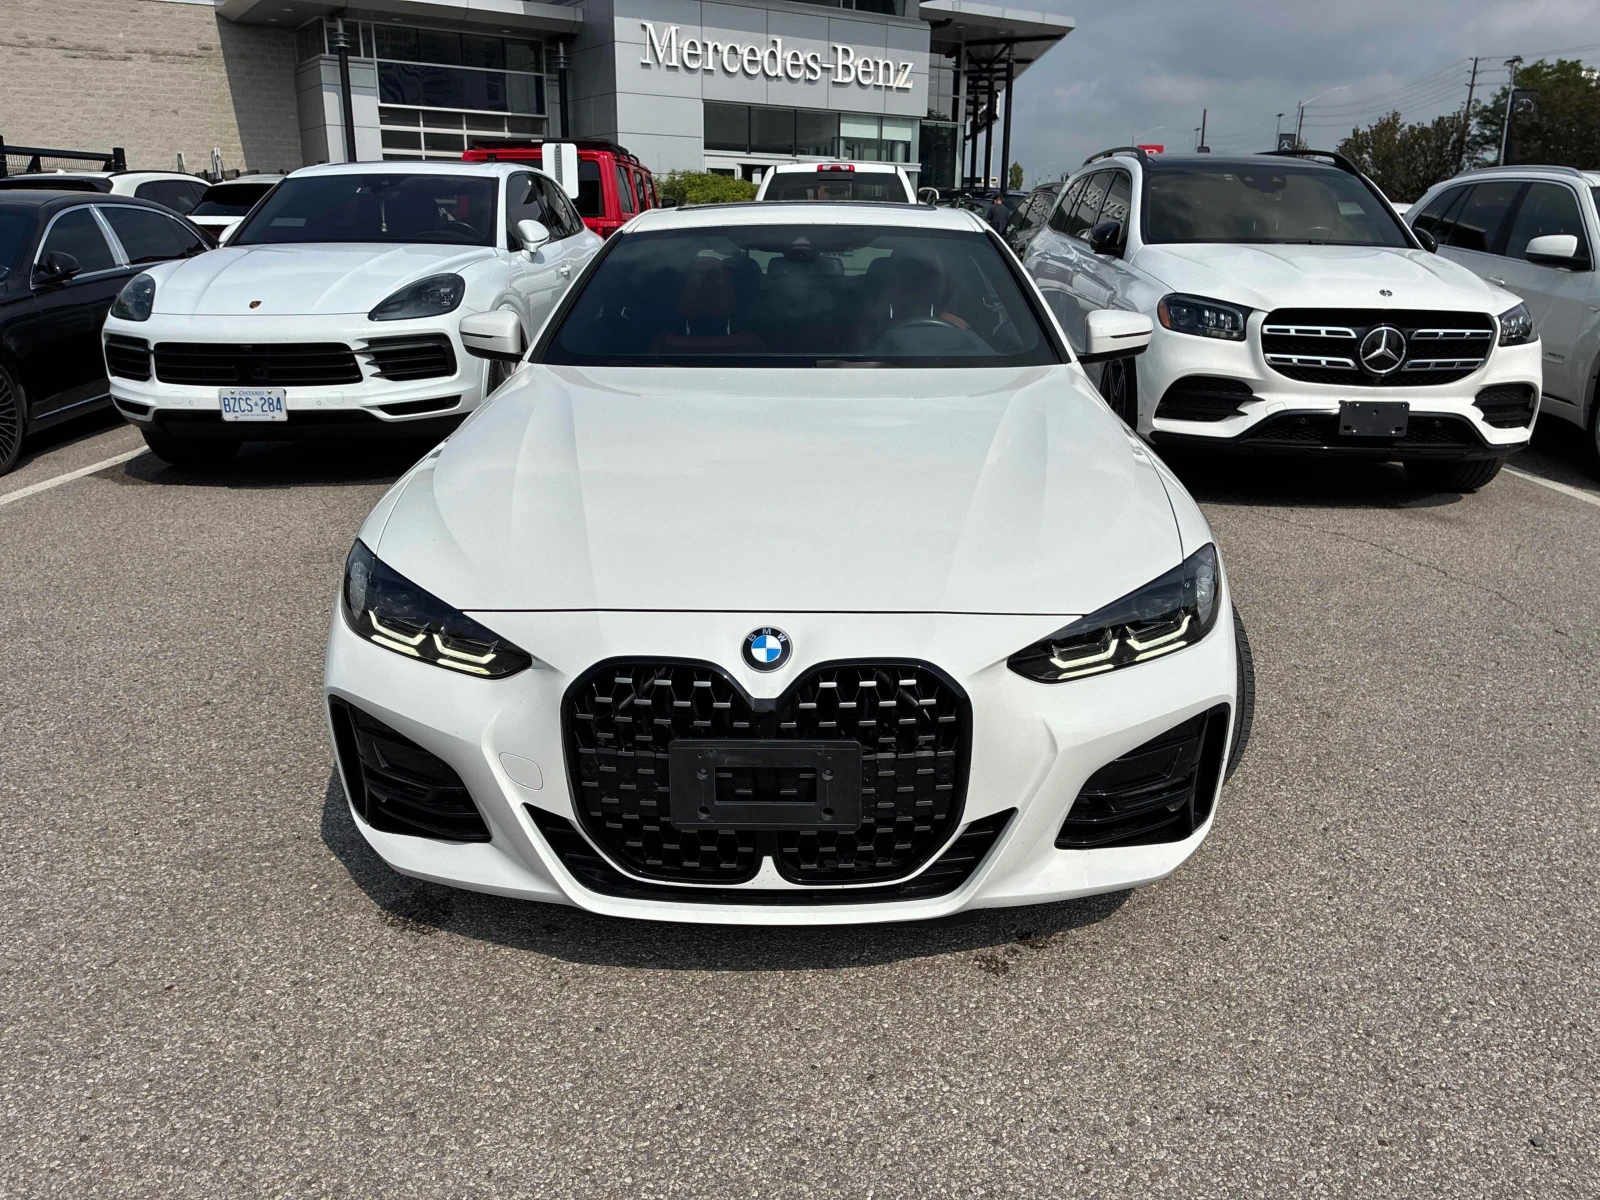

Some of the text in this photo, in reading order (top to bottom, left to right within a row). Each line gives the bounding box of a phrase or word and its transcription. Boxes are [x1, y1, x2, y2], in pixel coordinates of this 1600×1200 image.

[640, 21, 914, 90] Mercedes-Benz
[259, 396, 283, 413] 284
[747, 628, 787, 642] BMW
